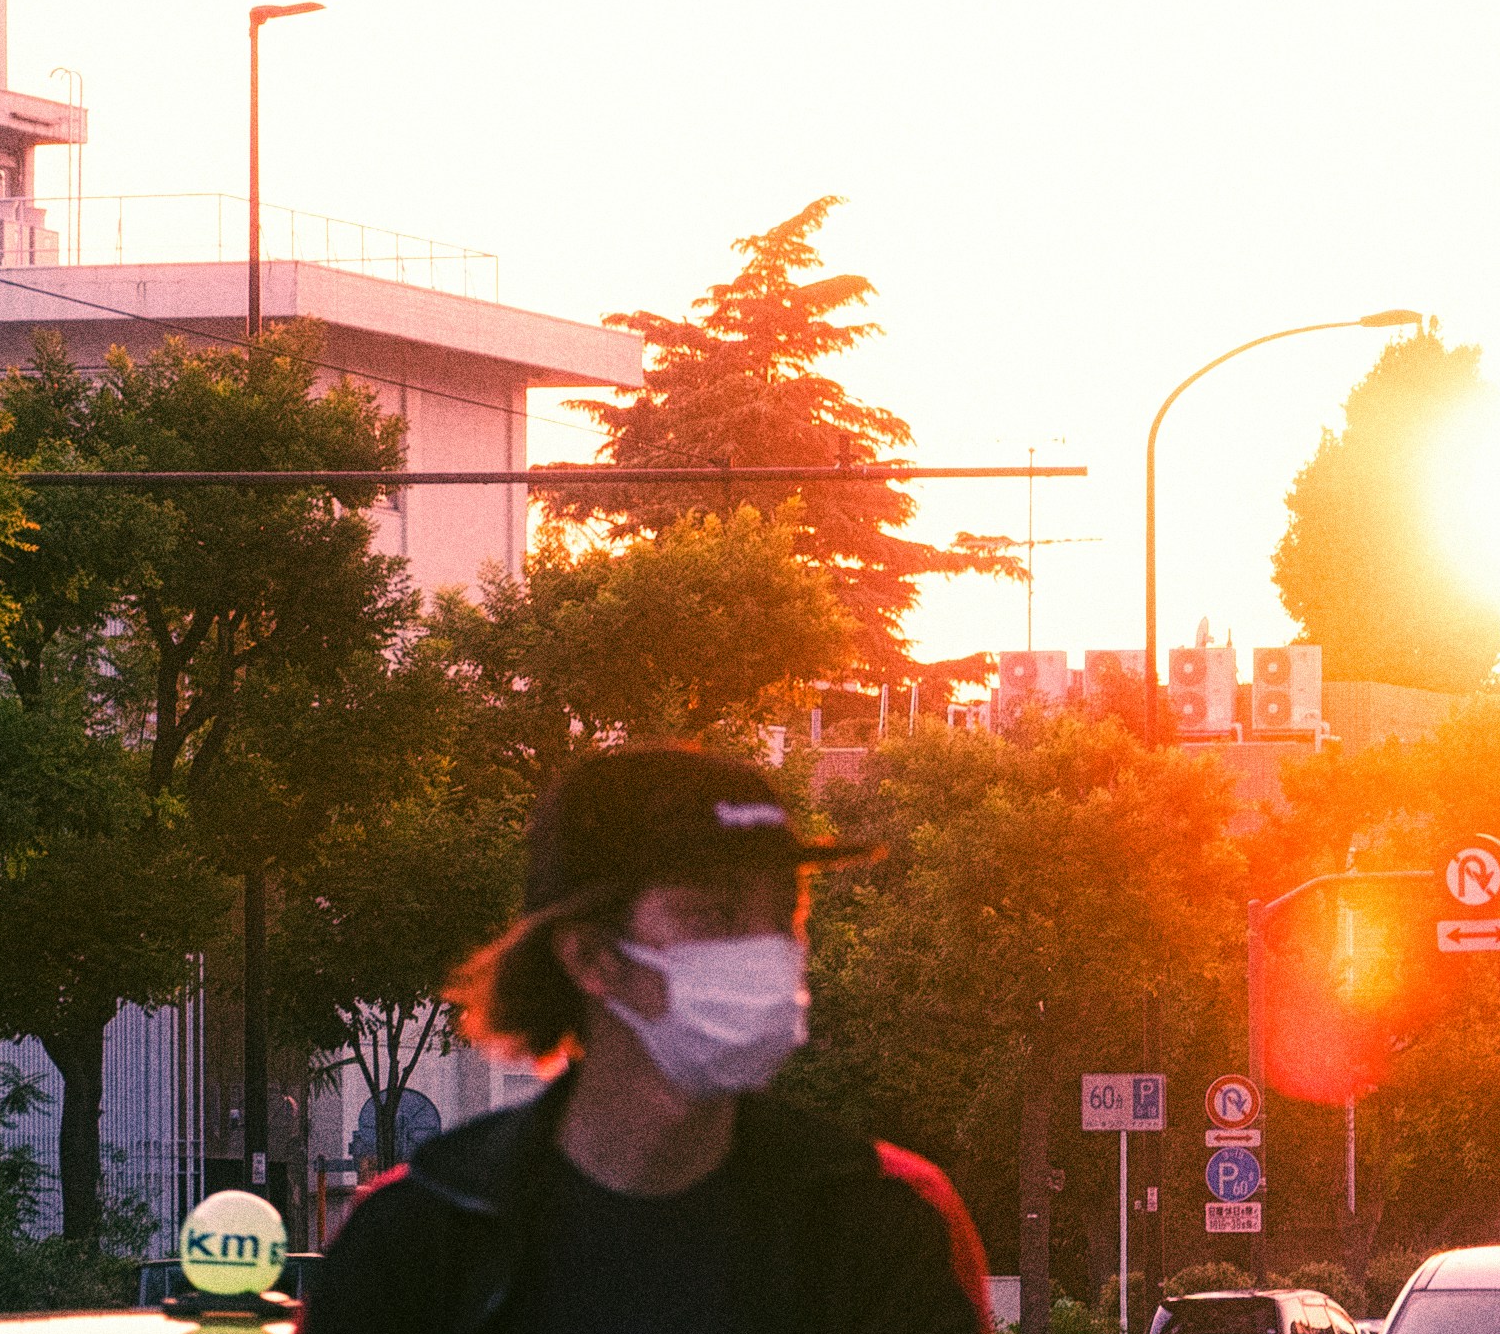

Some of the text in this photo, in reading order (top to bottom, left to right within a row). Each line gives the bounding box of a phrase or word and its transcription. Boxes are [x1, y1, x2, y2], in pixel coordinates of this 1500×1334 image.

[1140, 1082, 1154, 1105] P
[1219, 1162, 1239, 1195] P
[187, 1229, 259, 1259] km
